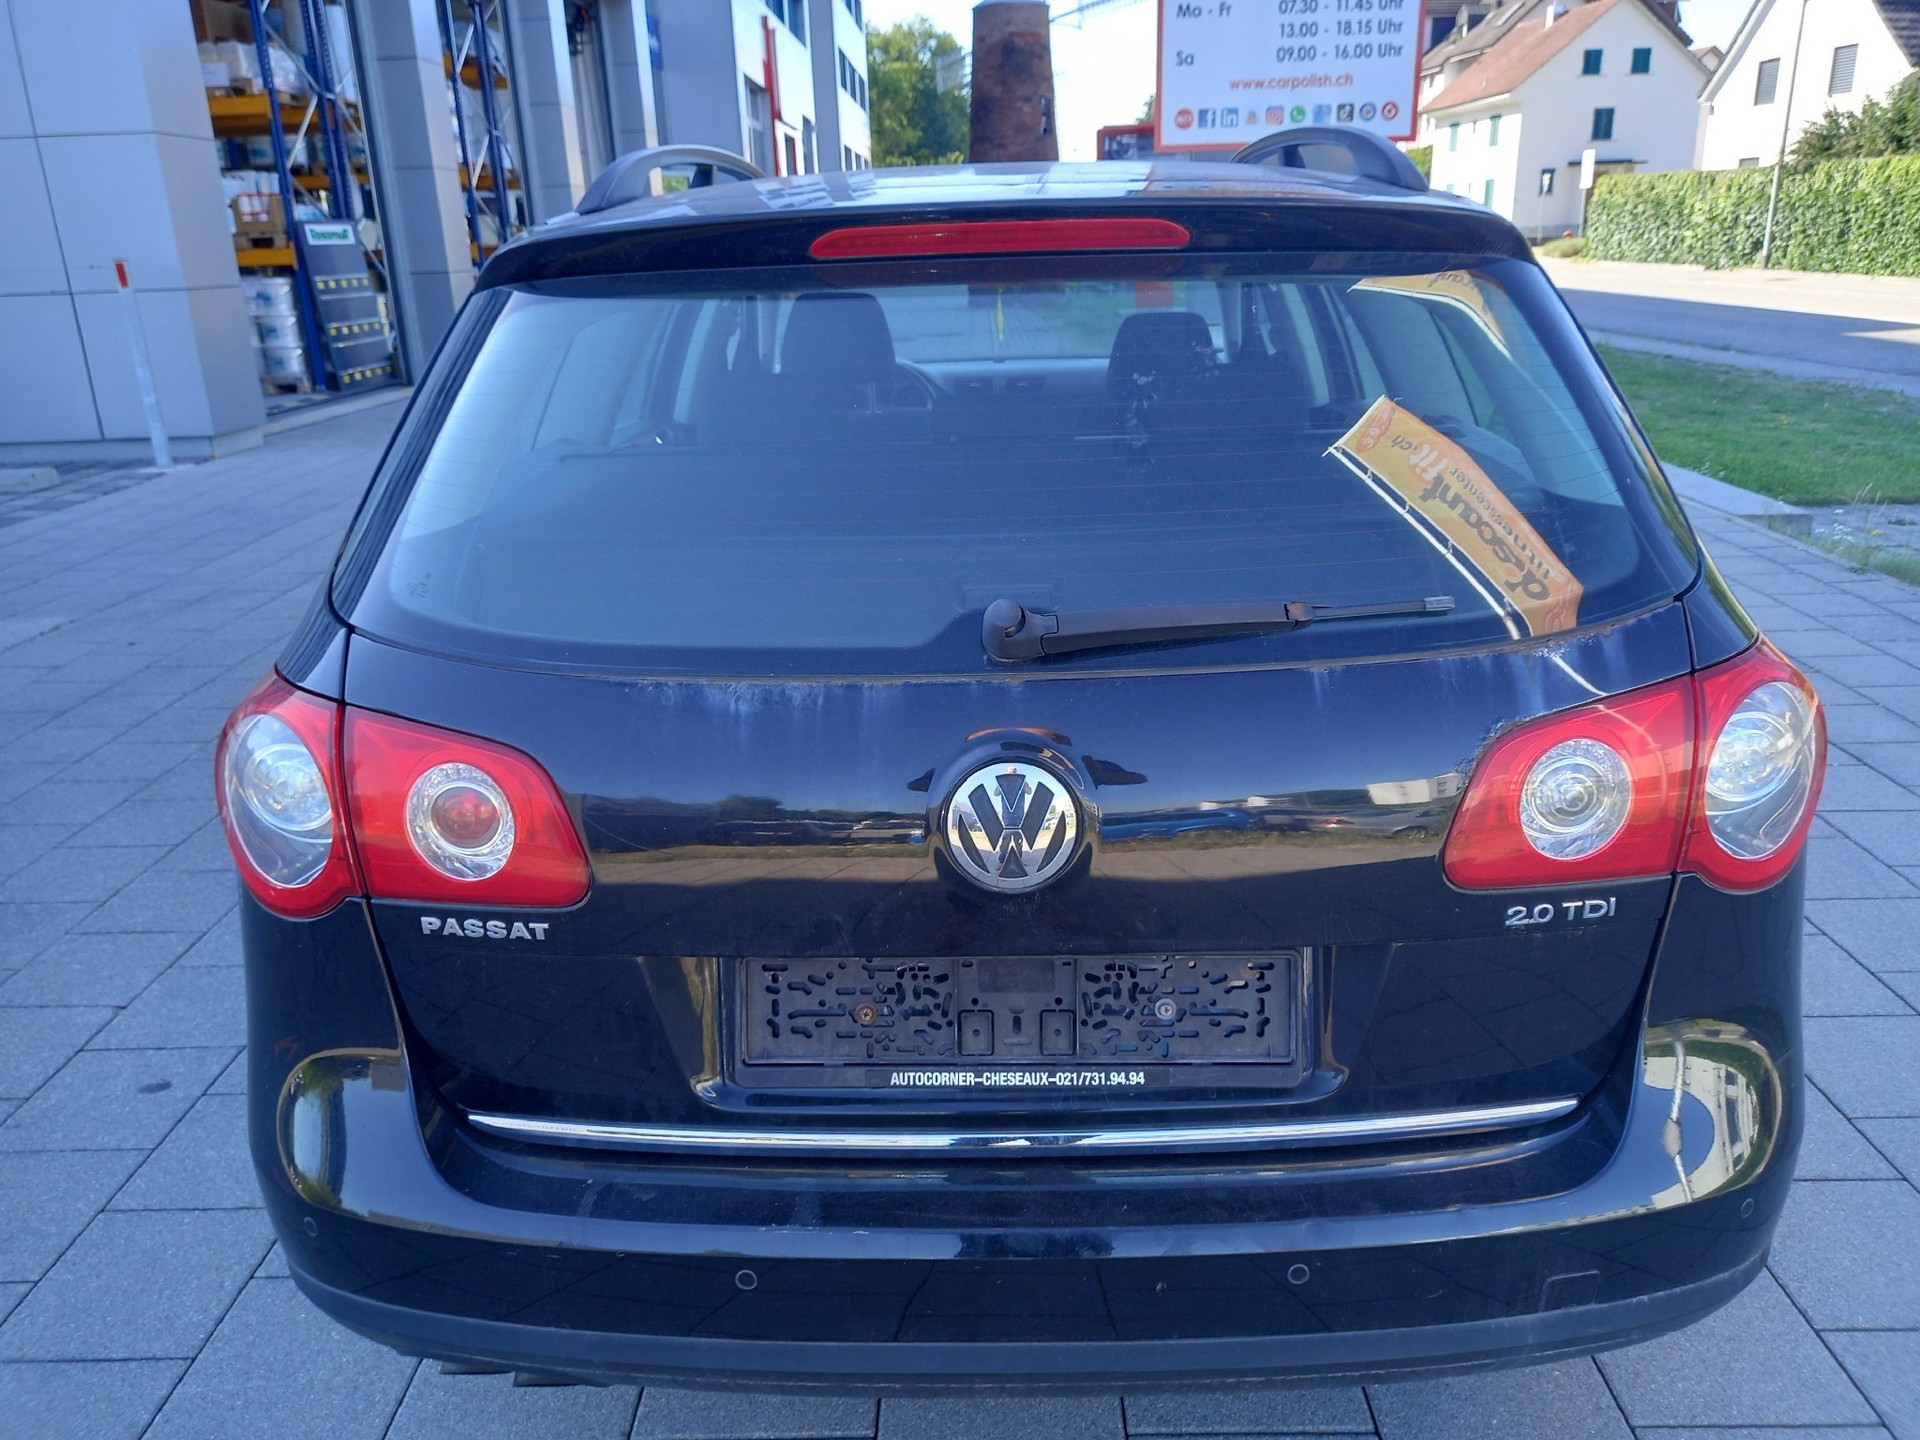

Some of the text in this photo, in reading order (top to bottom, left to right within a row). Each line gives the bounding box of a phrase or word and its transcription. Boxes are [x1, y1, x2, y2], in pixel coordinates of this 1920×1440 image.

[1177, 3, 1202, 19] Mo
[1219, 1, 1232, 17] Fr
[1278, 0, 1318, 15] 07.30
[1336, 0, 1373, 12] 11.45
[1377, 0, 1403, 11] Uhr
[1279, 21, 1319, 38] 13.00
[1336, 19, 1372, 36] 18.15
[1377, 18, 1403, 35] Uhr
[1176, 50, 1195, 67] Sa
[1276, 44, 1317, 62] 09.00
[1334, 43, 1373, 60] 16.00
[1377, 42, 1403, 58] Uhr
[1229, 72, 1354, 91] www.carpolish.ch
[1562, 896, 1616, 920] TDI
[420, 916, 550, 940] PASSAT
